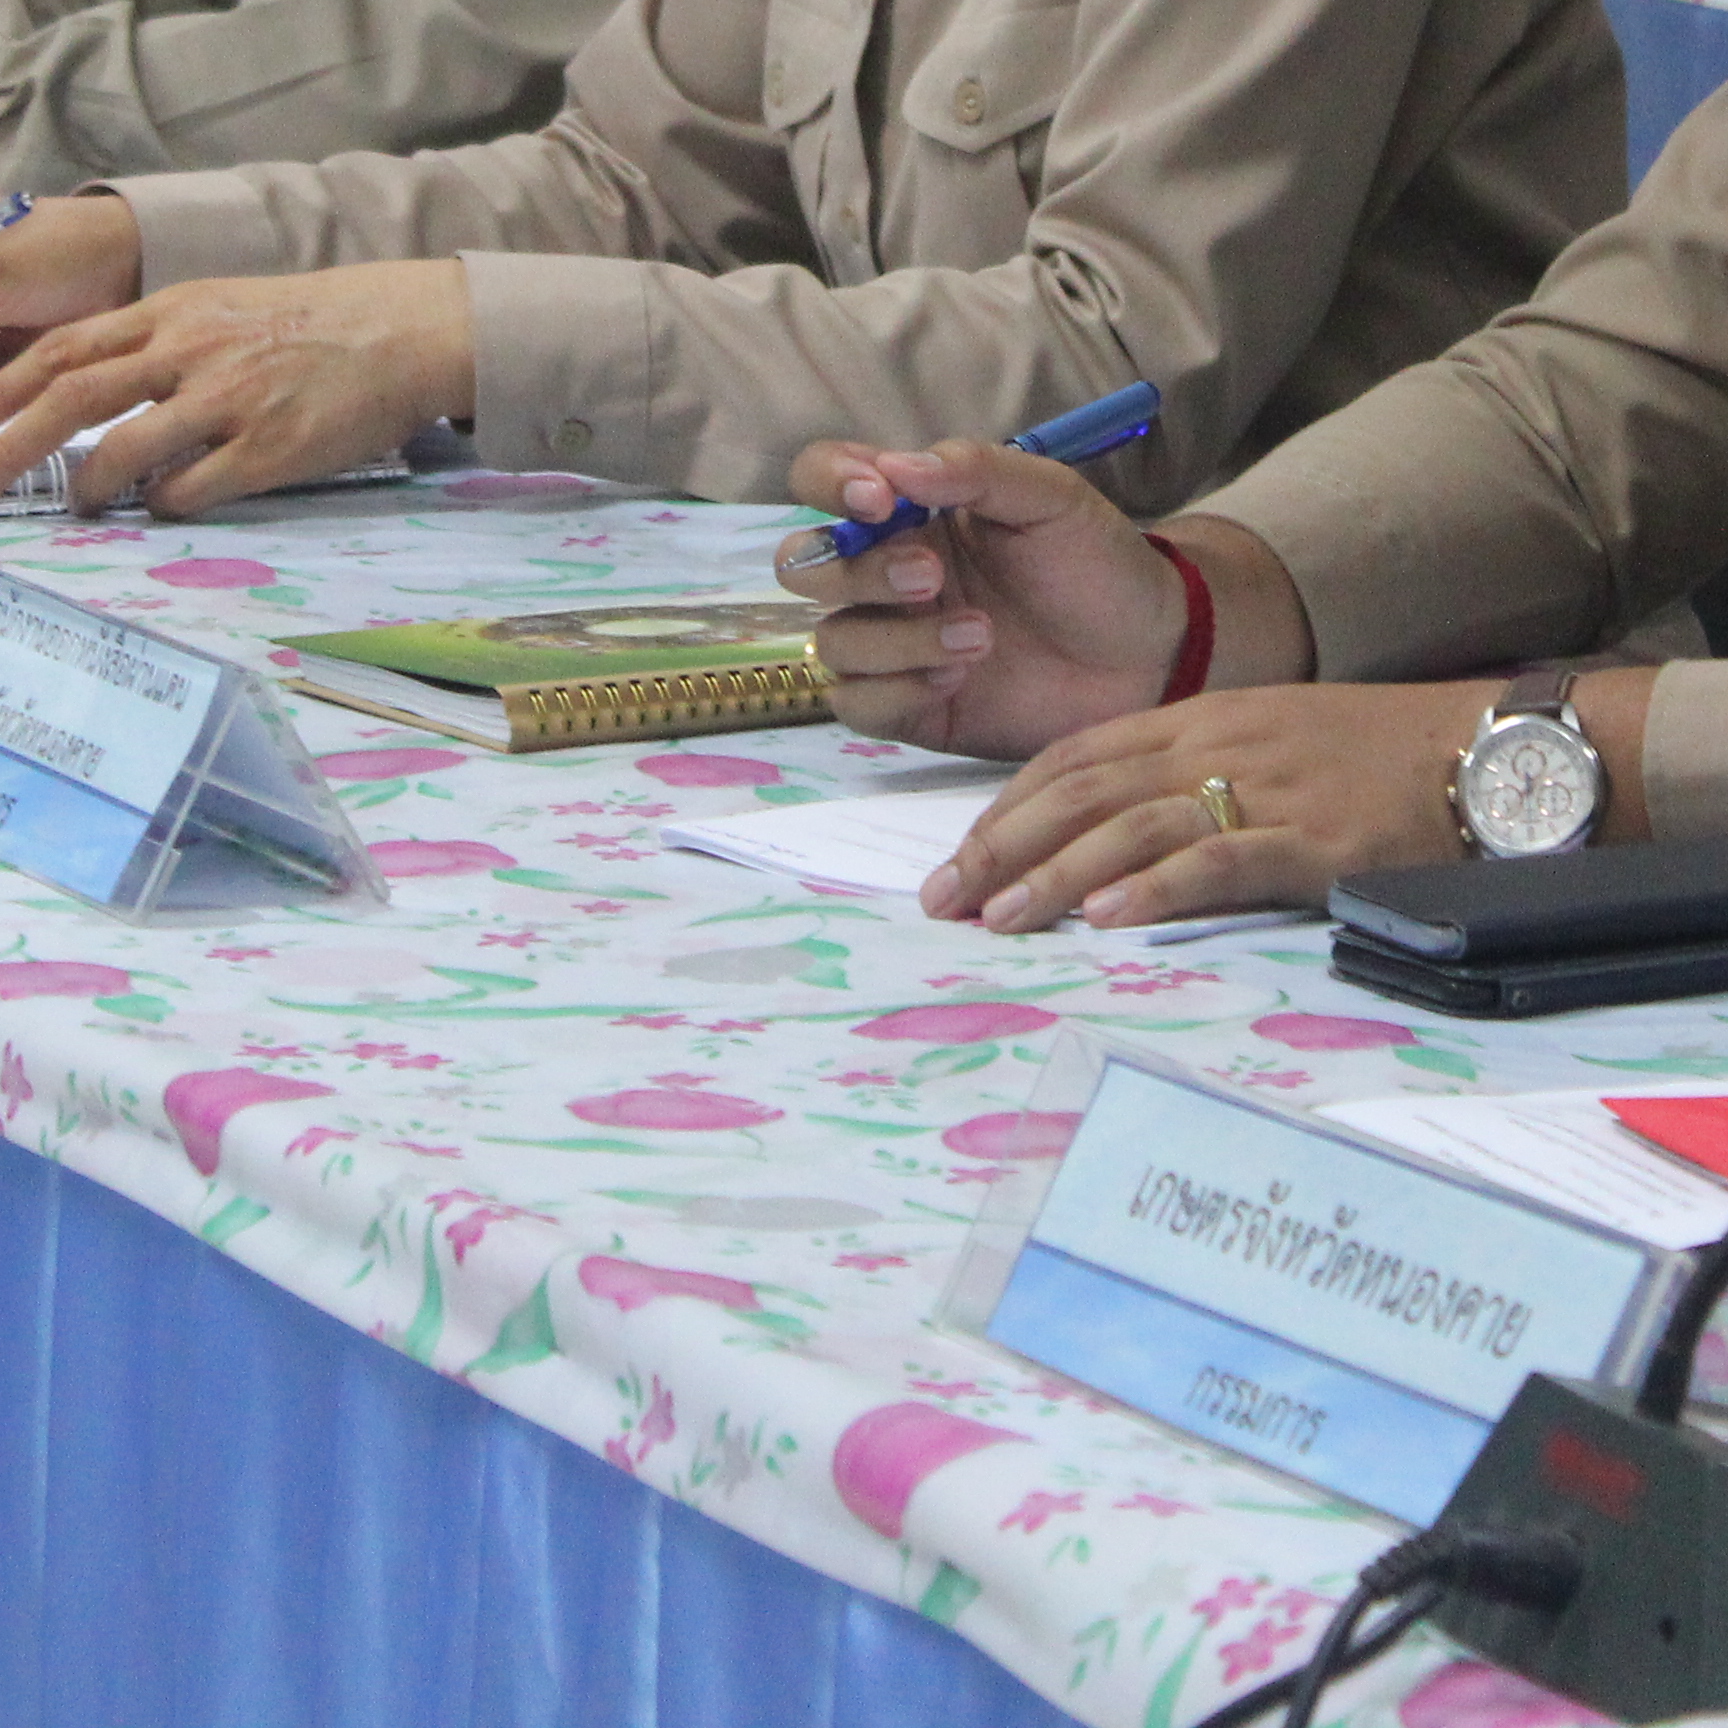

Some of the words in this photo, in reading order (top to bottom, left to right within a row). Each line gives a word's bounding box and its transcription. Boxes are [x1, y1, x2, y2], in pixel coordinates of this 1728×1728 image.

[1128, 1162, 1532, 1360] เกษตรจังหวัดหนองคาย
[1185, 1367, 1327, 1457] กรรมการ
